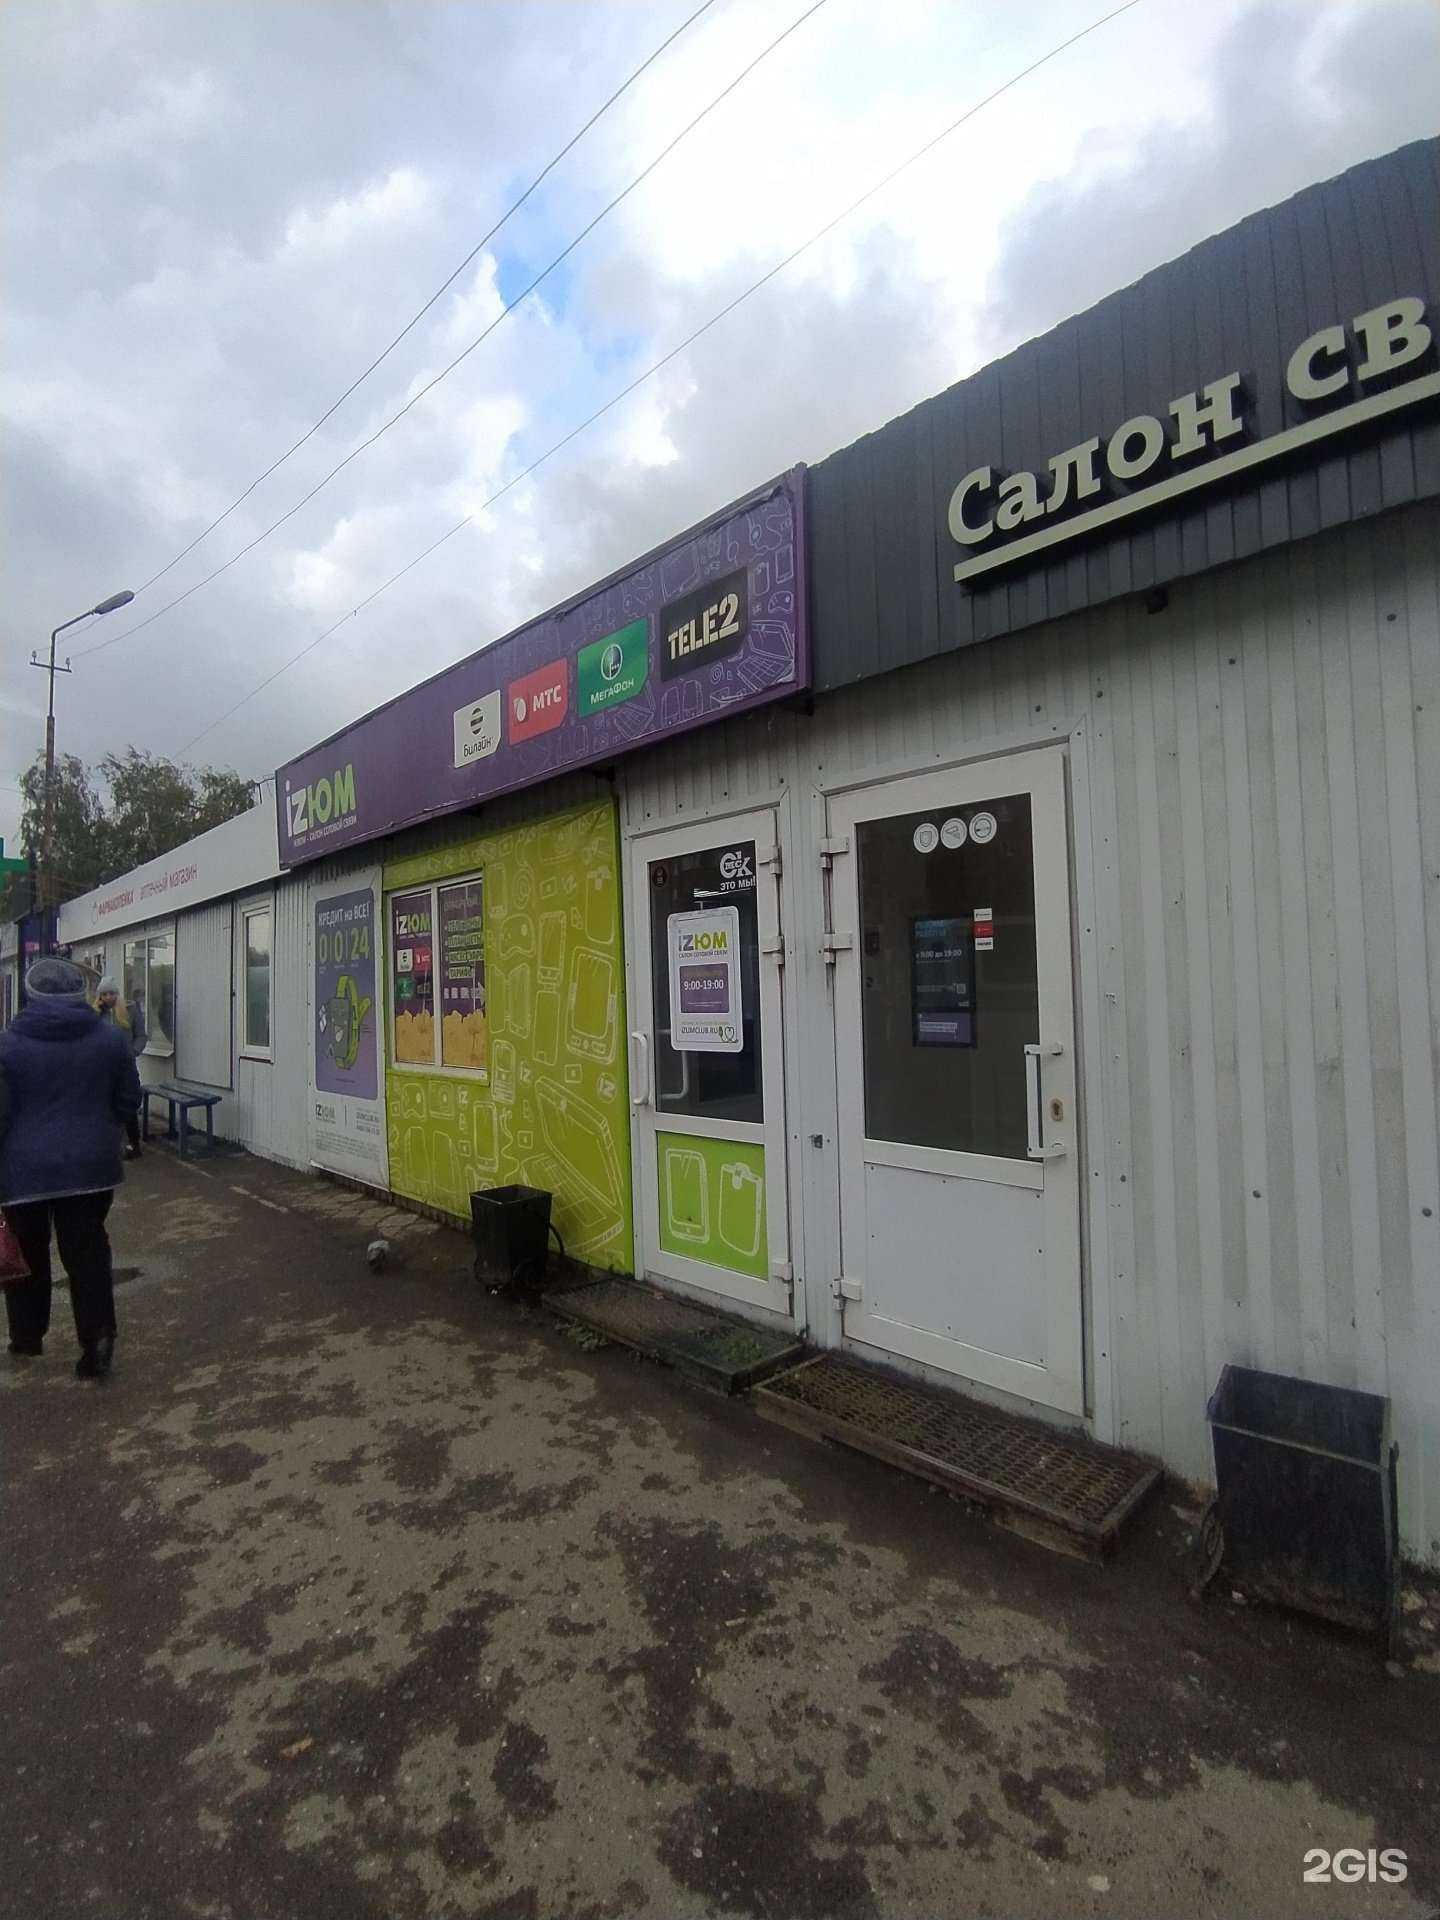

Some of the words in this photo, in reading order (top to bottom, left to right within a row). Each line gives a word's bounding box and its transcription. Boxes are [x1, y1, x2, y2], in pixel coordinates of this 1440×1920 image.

[948, 372, 1242, 545] Салон
[668, 593, 739, 660] TELE2
[533, 685, 561, 712] МТС
[464, 736, 491, 757] билайн
[720, 881, 735, 890] ЭТО
[319, 908, 343, 928] КРЕДИТ
[683, 979, 724, 991] 9:00-19:00
